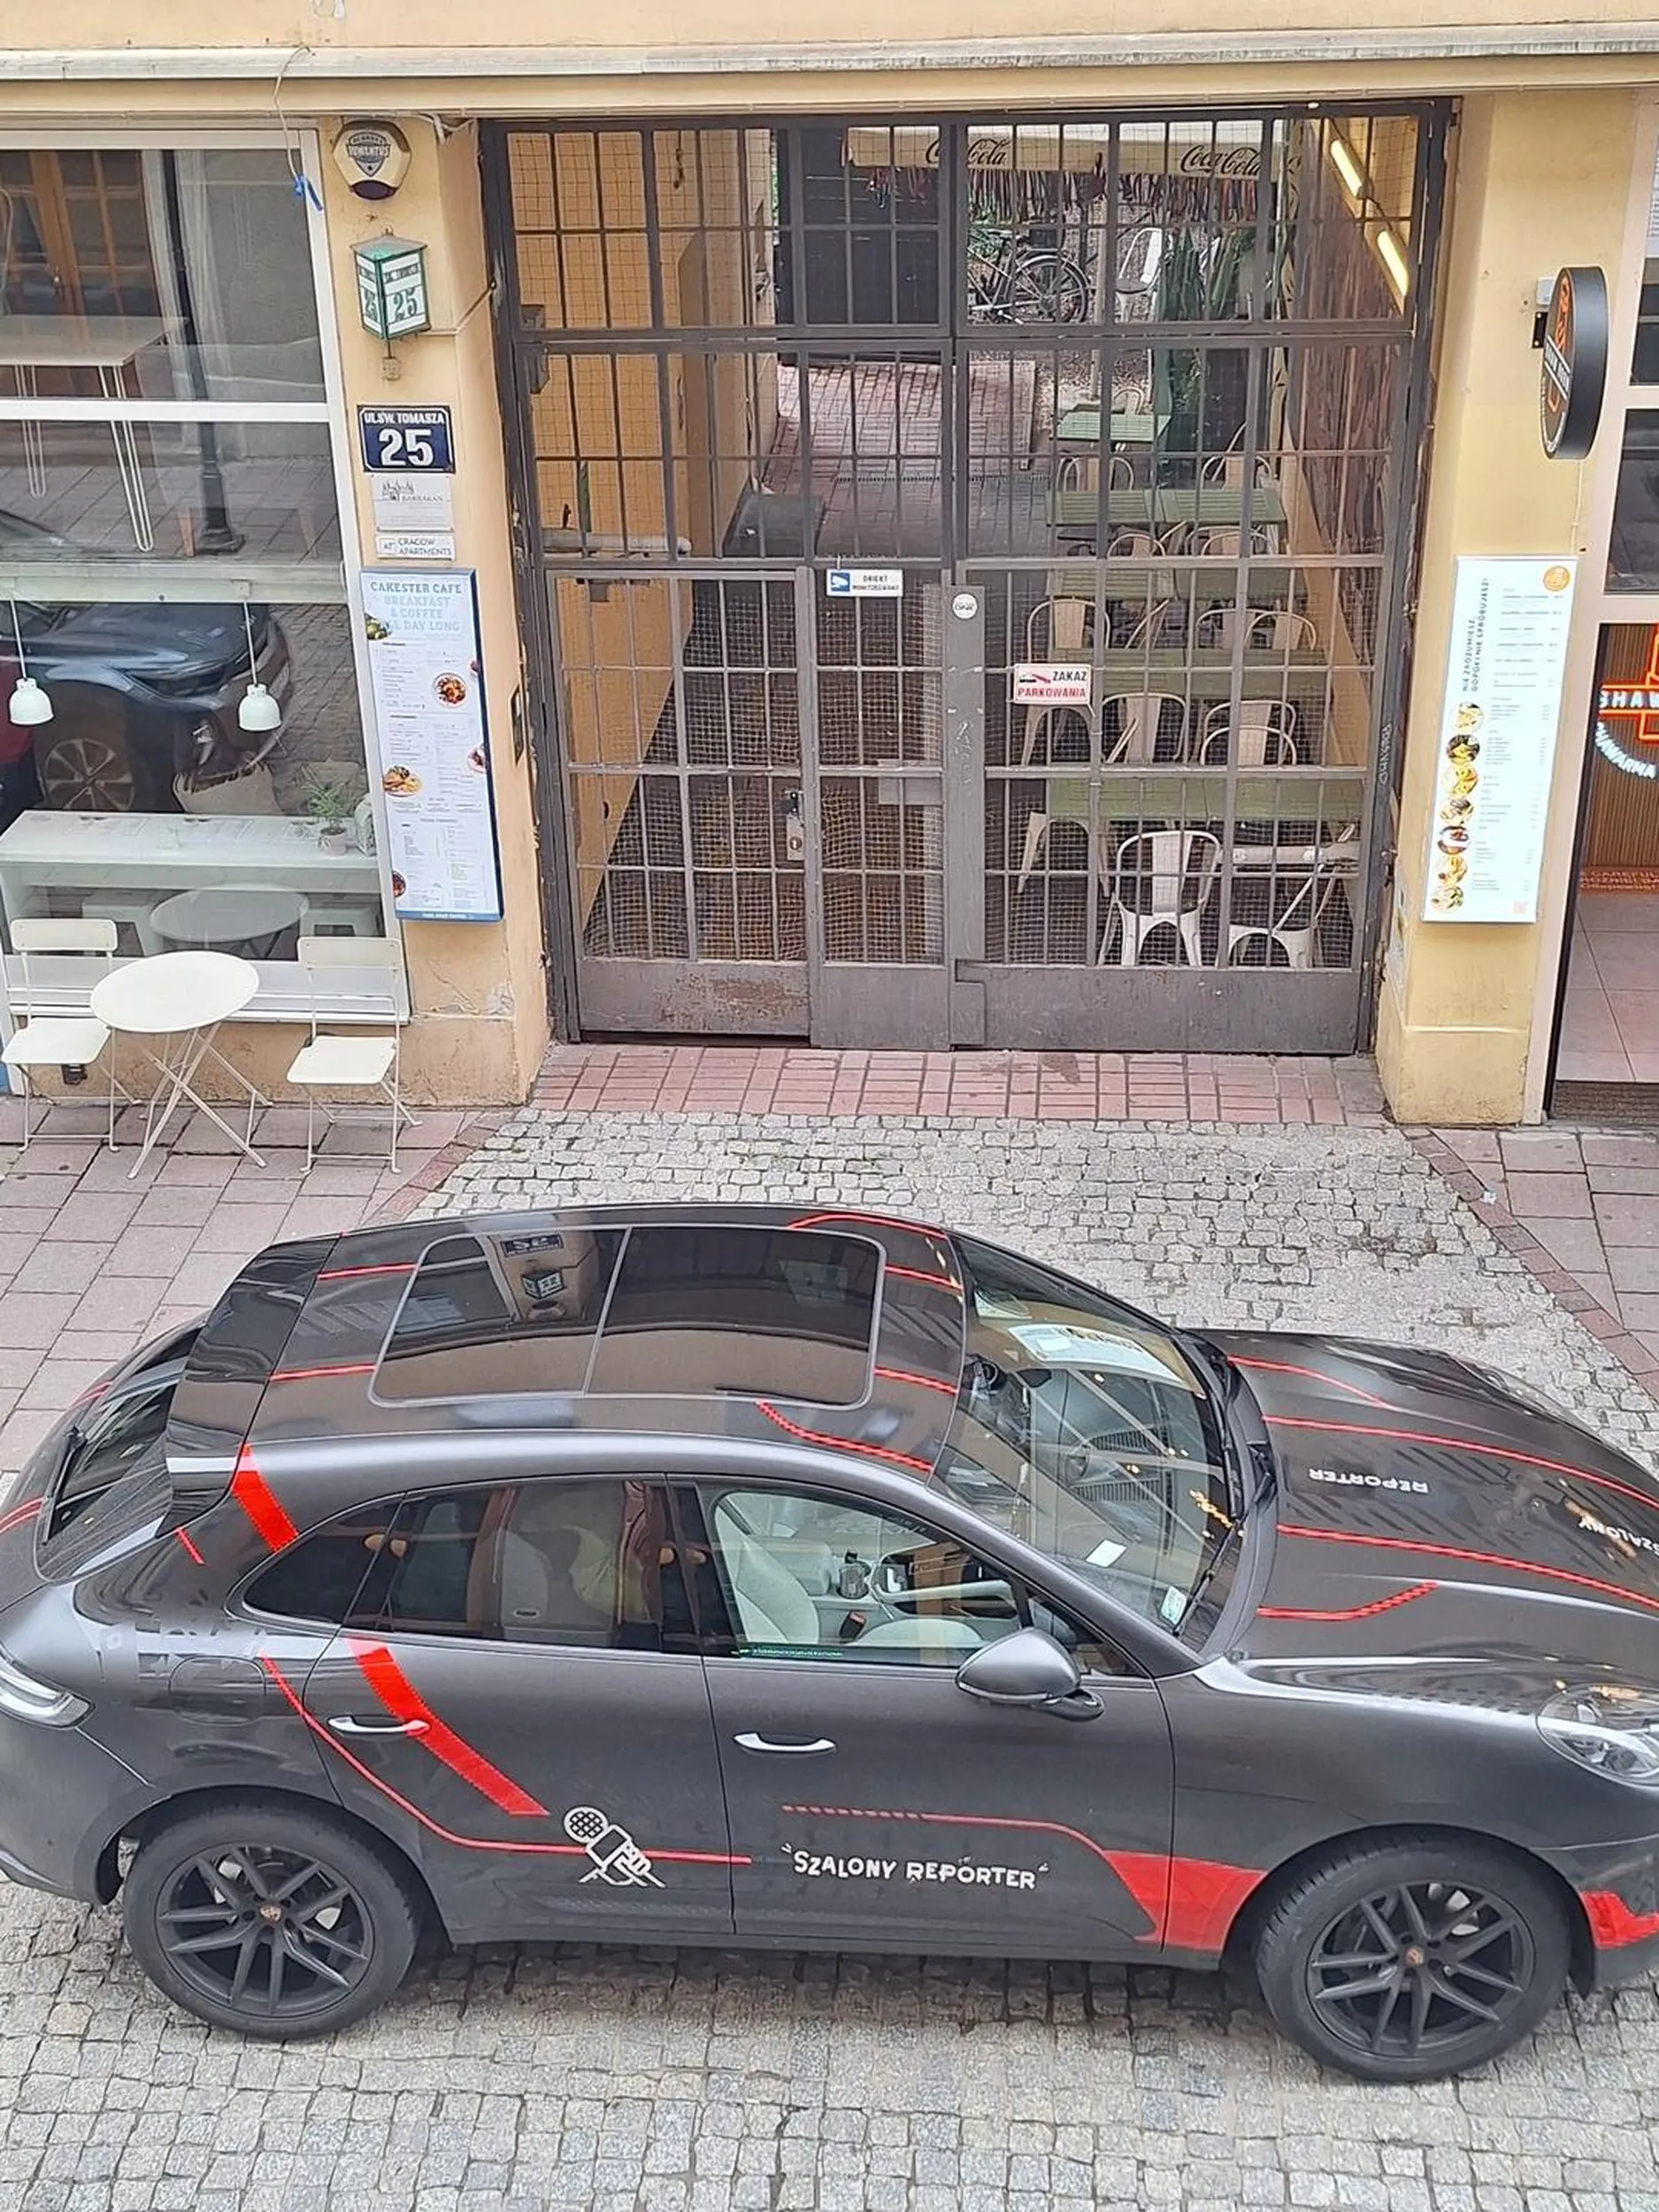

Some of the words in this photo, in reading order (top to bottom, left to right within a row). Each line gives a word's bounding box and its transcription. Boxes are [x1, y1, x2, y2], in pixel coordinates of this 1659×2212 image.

[393, 287, 418, 322] 25
[397, 412, 445, 425] TOMASZA
[379, 428, 434, 466] 25
[397, 537, 436, 547] CRACOW
[399, 547, 452, 557] APARTMENTS
[370, 581, 430, 594] CAKESTER
[433, 583, 462, 594] CAFE
[384, 595, 450, 607] BREAKFAST
[400, 608, 443, 619] COFFEE
[404, 620, 426, 631] DAY
[430, 621, 460, 632] LONG
[1052, 671, 1087, 681] ZAKAZ
[1018, 687, 1086, 697] PARKOWANIA
[1310, 1469, 1428, 1493] REPORTER
[793, 1850, 897, 1879] SZALONY
[905, 1862, 1036, 1890] REPORTER
